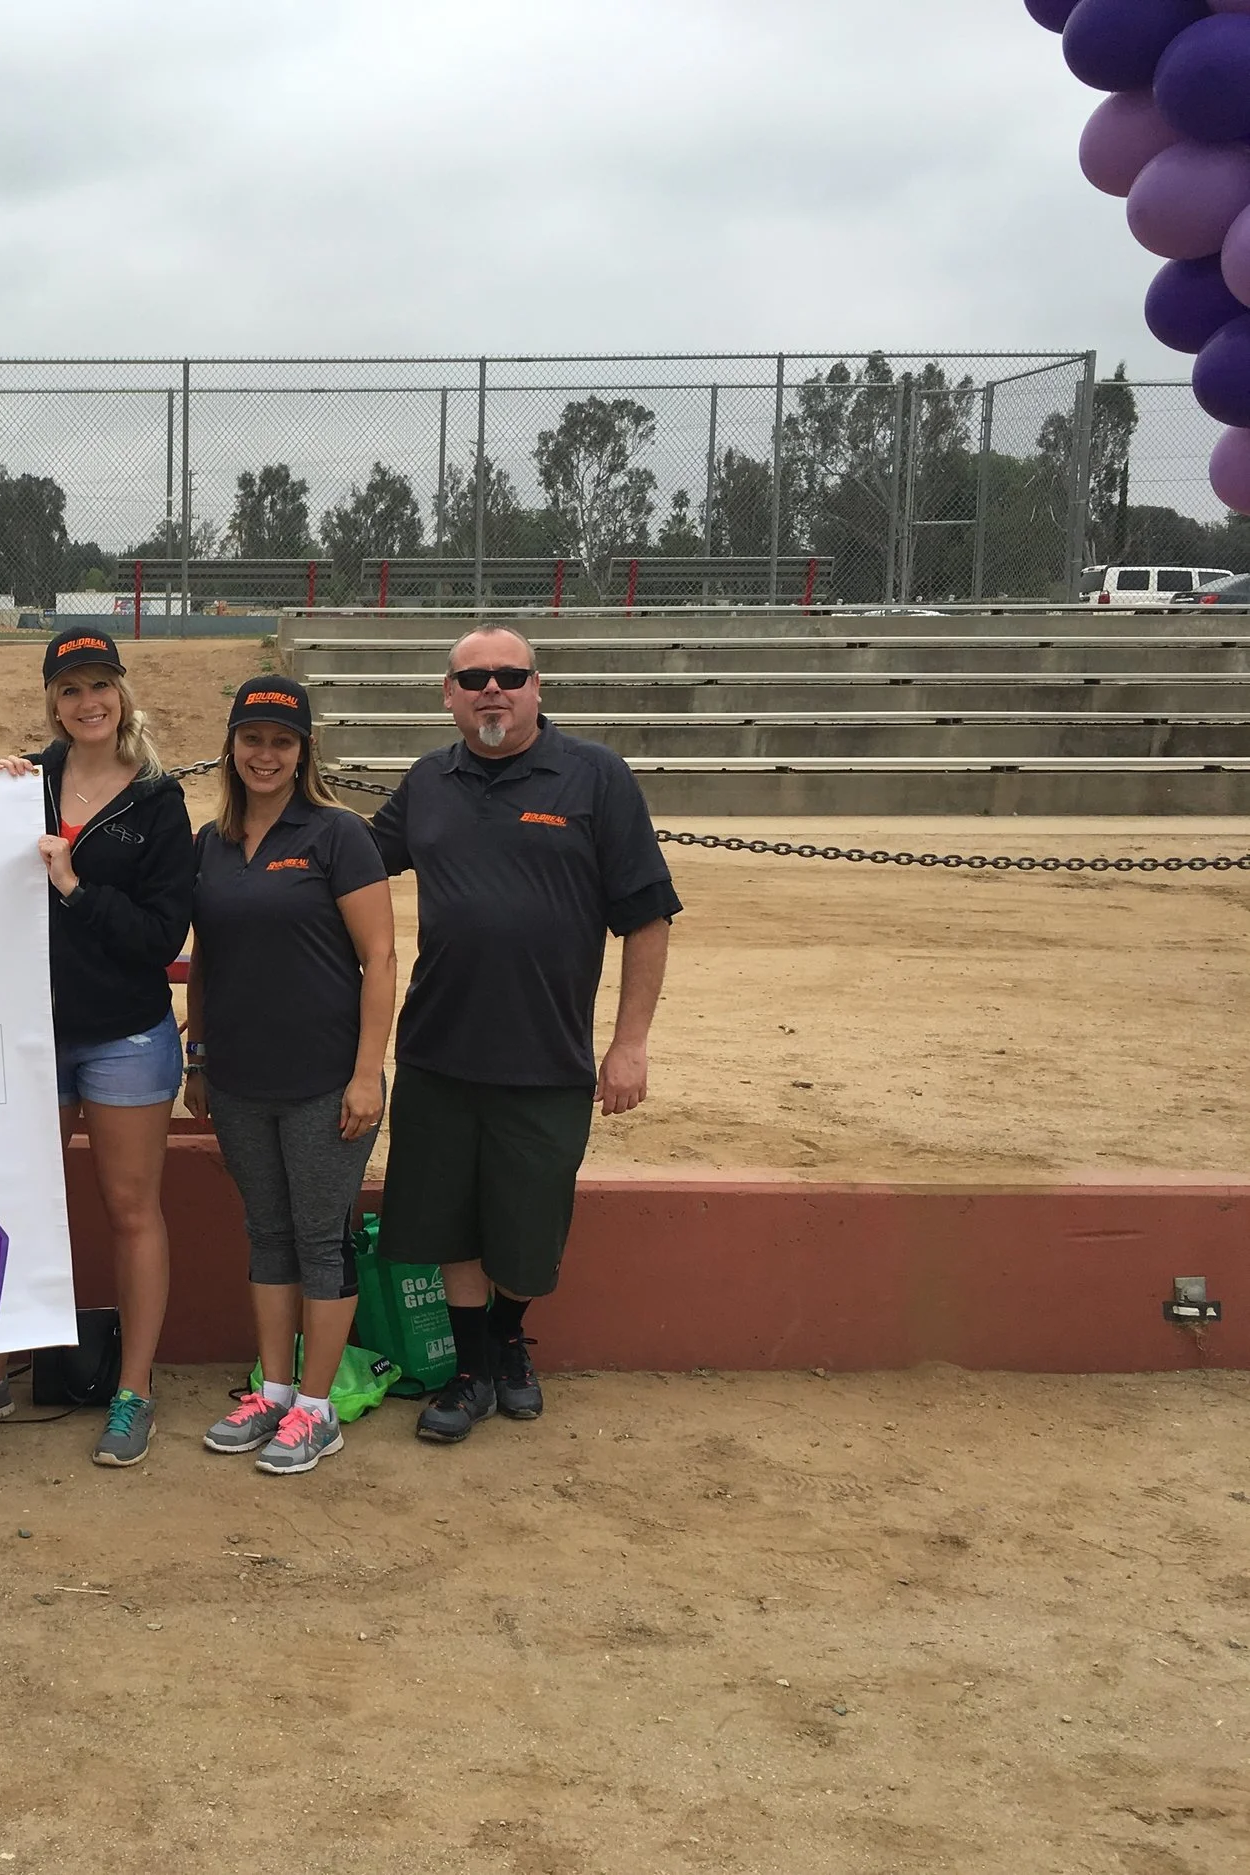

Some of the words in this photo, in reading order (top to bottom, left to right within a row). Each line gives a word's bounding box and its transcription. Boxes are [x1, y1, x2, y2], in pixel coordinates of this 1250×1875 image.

[57, 637, 107, 657] BOUDREAU
[245, 692, 298, 705] BOUDREAU
[401, 1277, 428, 1294] Go
[404, 1288, 447, 1308] Gree
